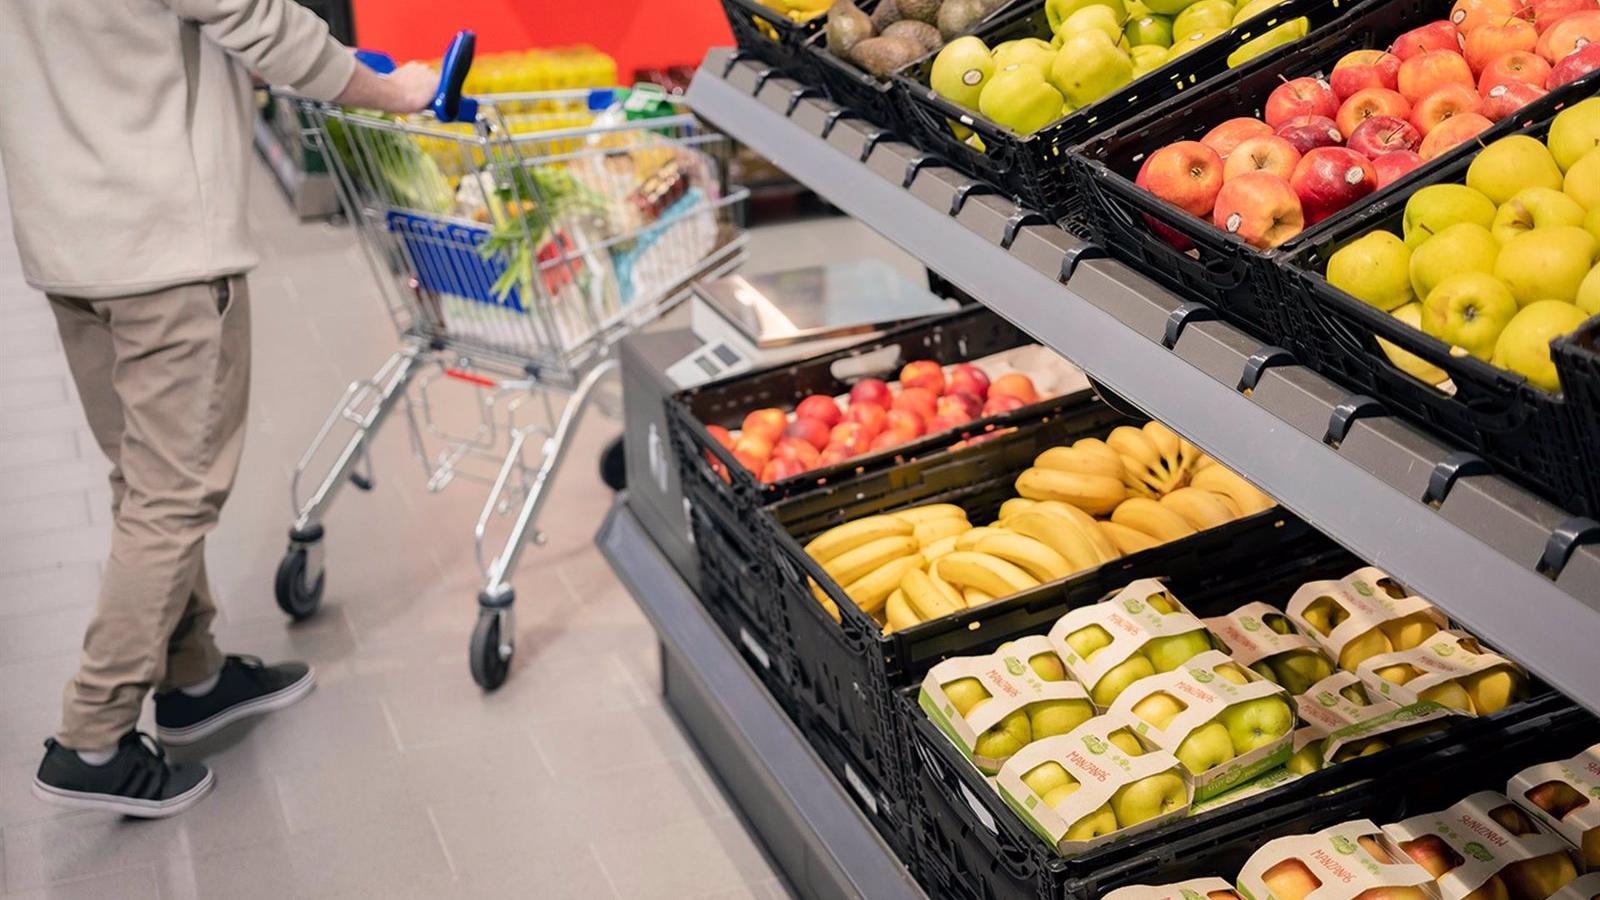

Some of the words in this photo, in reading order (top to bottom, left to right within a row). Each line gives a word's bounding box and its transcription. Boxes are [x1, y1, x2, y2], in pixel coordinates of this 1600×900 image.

[1066, 751, 1111, 782] MANZANAS
[1458, 815, 1509, 847] MANZANAS
[1310, 849, 1357, 883] MANZANAS
